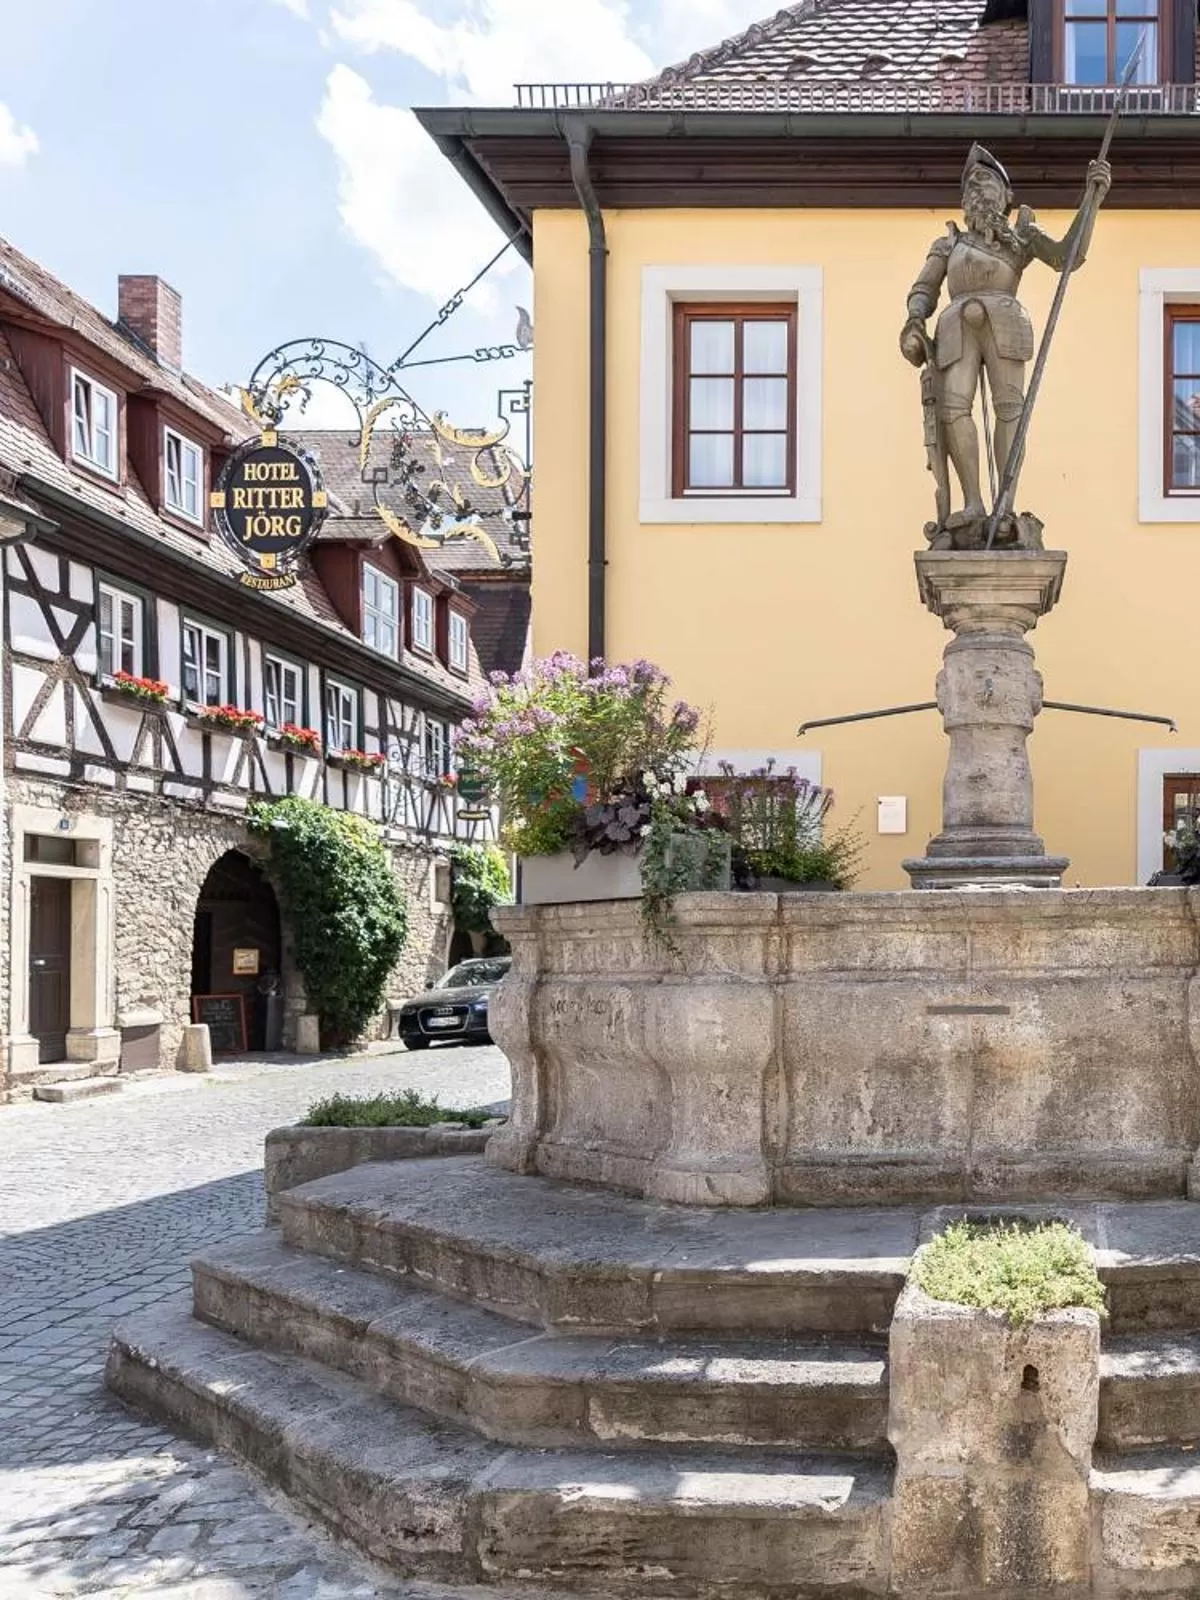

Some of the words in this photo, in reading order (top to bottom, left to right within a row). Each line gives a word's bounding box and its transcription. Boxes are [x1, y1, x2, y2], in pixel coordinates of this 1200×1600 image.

[243, 463, 300, 481] HOTEL
[232, 487, 305, 509] RITTER
[243, 511, 302, 541] JÖRG
[241, 571, 298, 589] RESTAURANT
